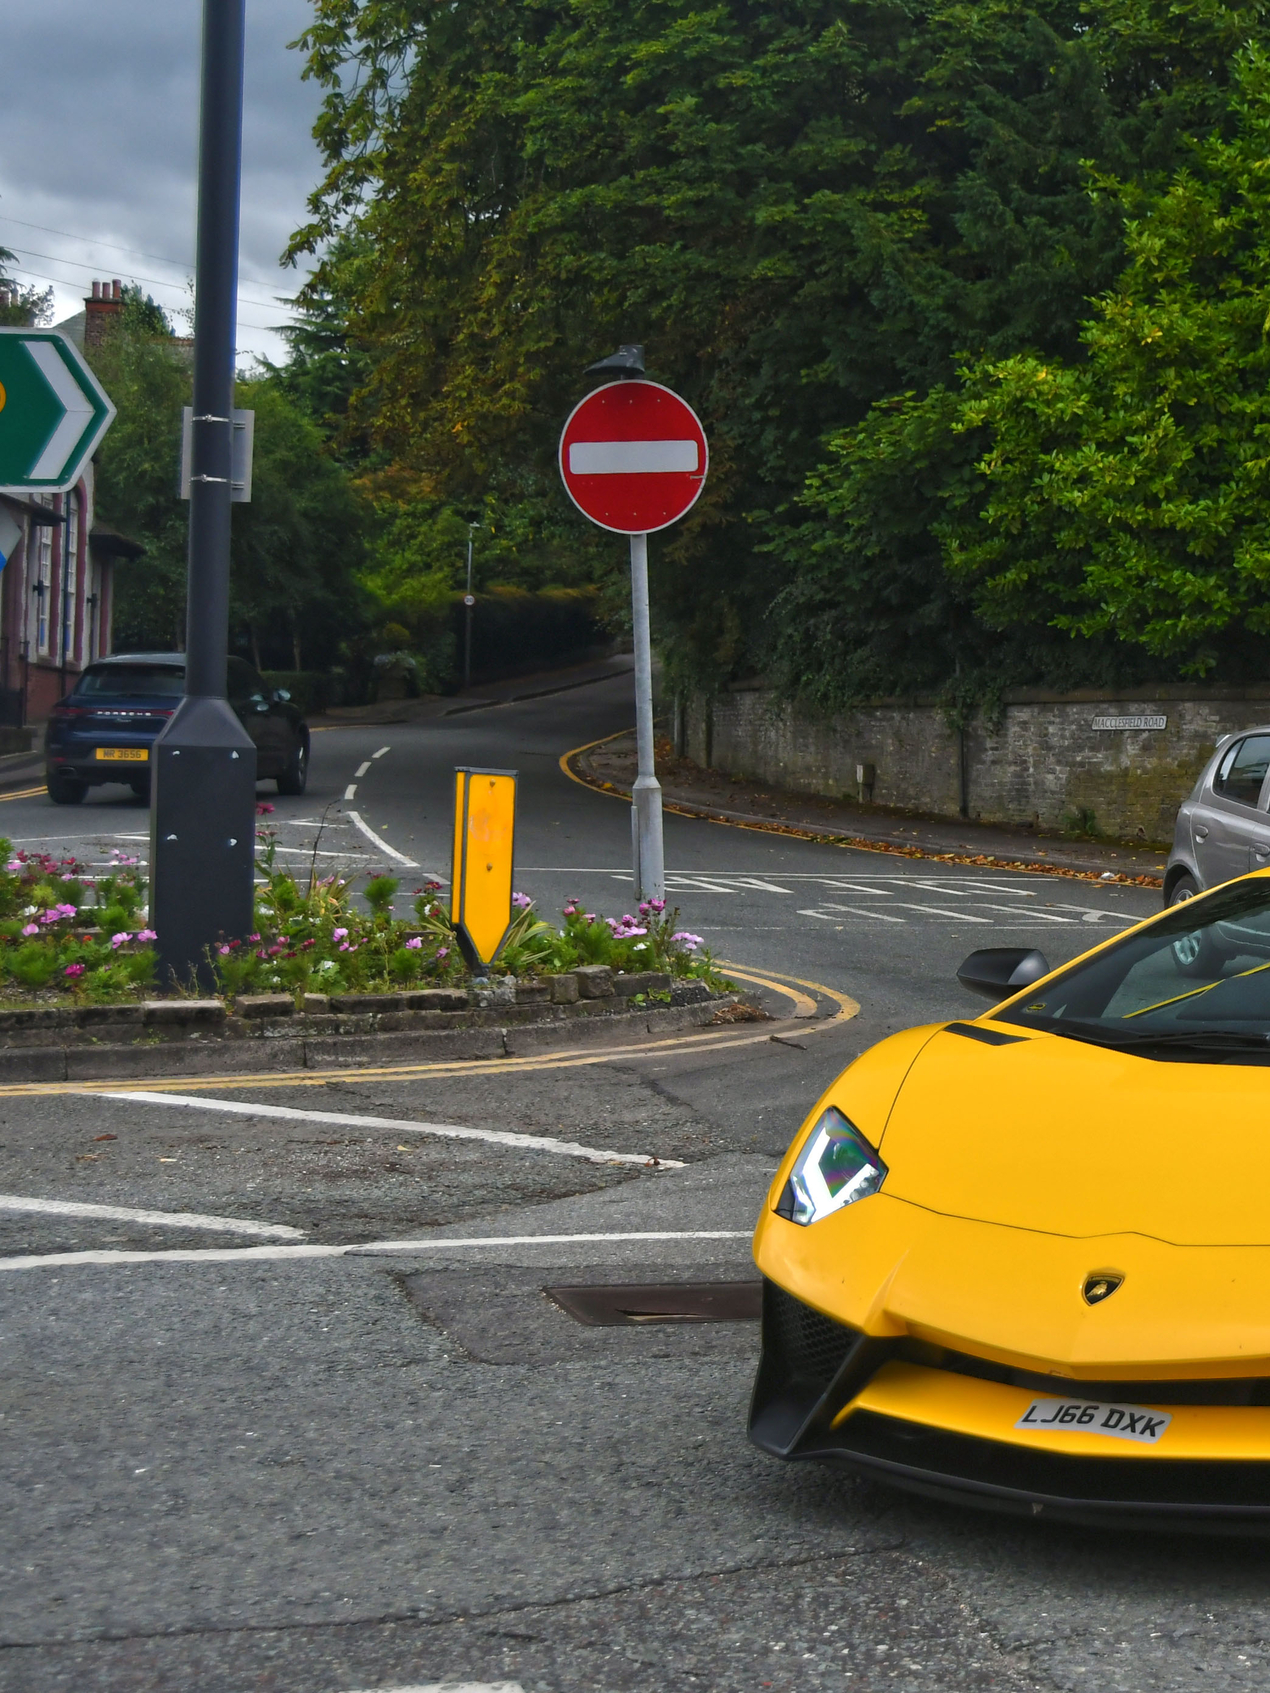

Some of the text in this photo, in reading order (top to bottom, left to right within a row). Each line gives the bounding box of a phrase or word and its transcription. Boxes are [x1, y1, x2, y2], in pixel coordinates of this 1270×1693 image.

[1093, 716, 1165, 729] MACCLESFIELD ROAD
[1021, 1404, 1165, 1438] LJ66 DXK
